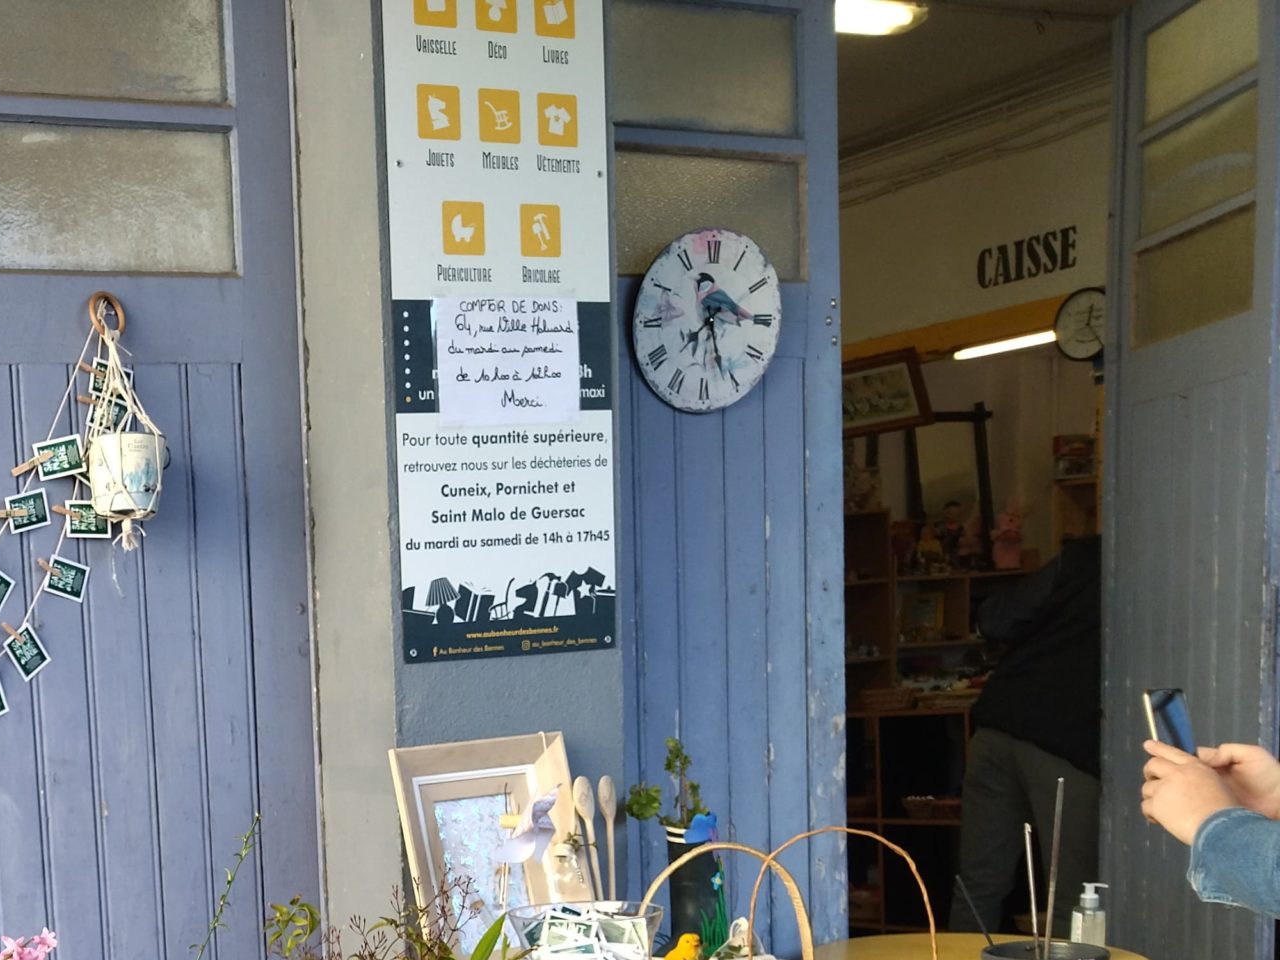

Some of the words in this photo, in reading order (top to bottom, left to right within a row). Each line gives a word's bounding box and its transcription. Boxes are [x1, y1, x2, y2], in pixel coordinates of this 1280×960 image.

[976, 225, 1078, 289] CAISSE
[512, 300, 527, 314] DE
[402, 433, 431, 446] Pour
[435, 433, 467, 445] toute
[472, 431, 529, 447] quantité
[533, 430, 608, 446] supérieure,
[404, 460, 457, 473] retrouvez
[461, 461, 488, 471] nous
[491, 461, 508, 471] sur
[512, 457, 527, 470] les
[595, 454, 607, 467] de
[441, 483, 491, 499] Cuneix,
[496, 481, 559, 495] Pornichet
[563, 481, 575, 493] et
[432, 510, 466, 524] Saint
[471, 508, 506, 522] Malo
[510, 507, 526, 520] de
[531, 505, 585, 519] Guersac
[405, 538, 420, 551] du
[424, 536, 459, 550] mardi
[463, 538, 477, 548] au
[480, 533, 521, 547] samedi
[525, 532, 539, 545] de
[543, 532, 562, 544] 14h
[566, 532, 573, 542] à
[577, 530, 610, 542] 17h45
